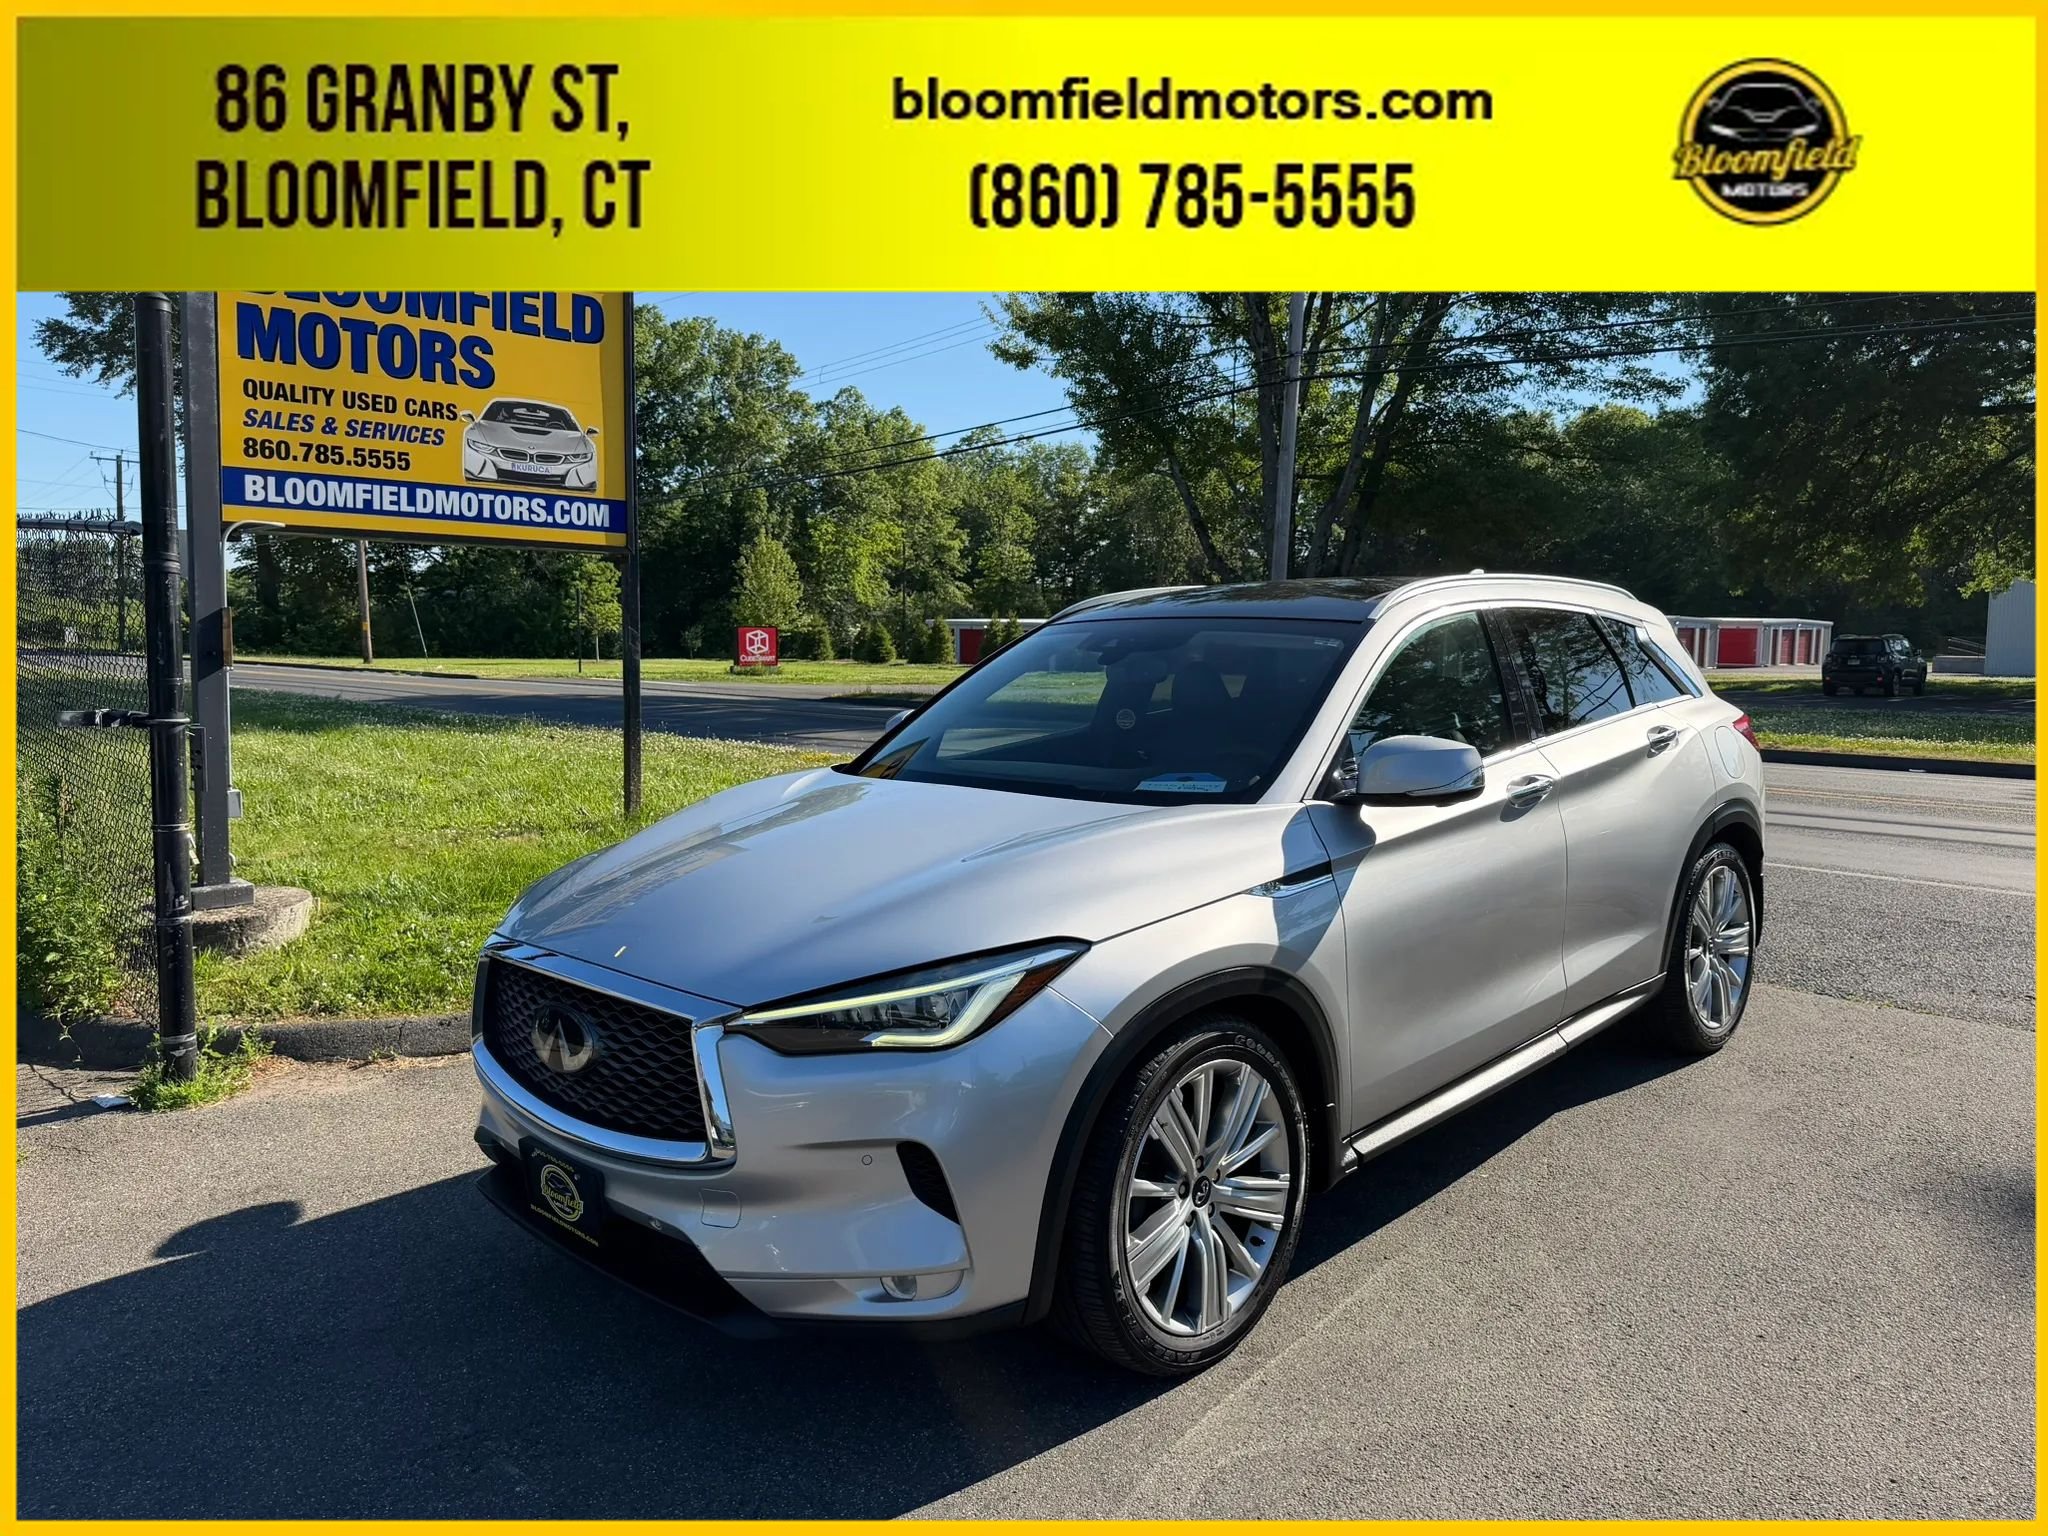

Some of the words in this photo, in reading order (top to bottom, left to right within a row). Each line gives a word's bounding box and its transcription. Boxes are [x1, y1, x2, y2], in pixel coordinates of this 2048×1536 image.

[241, 291, 605, 345] MFIELD
[236, 301, 496, 389] MOTORS
[242, 378, 335, 407] QUALITY
[342, 390, 398, 414] USED
[404, 398, 459, 422] CARS
[242, 408, 315, 433] SALES
[320, 416, 338, 436] &
[344, 419, 446, 446] SERVICES
[243, 437, 411, 471] 860.785.5555
[243, 474, 611, 528] BLOOMFIELDMOTORS.COM
